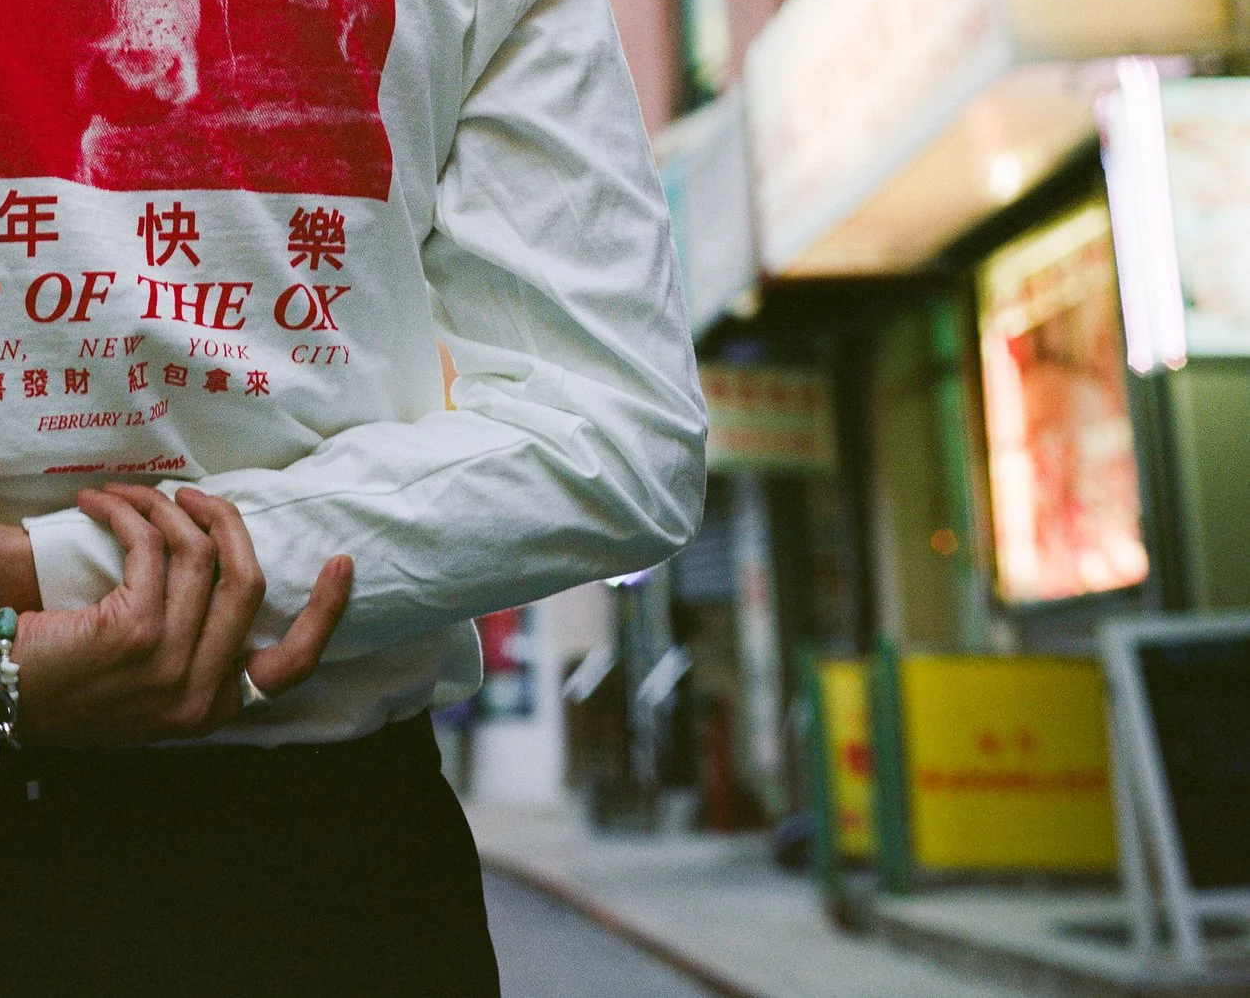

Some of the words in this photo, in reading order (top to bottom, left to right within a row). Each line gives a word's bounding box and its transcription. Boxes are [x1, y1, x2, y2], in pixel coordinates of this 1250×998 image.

[24, 270, 116, 324] OF
[137, 273, 253, 331] THE
[273, 282, 351, 331] OX
[78, 334, 146, 360] NEW
[188, 336, 250, 360] YORK
[37, 411, 122, 432] FEBRUARY
[125, 410, 146, 427] 12,
[149, 399, 169, 421] 2021
